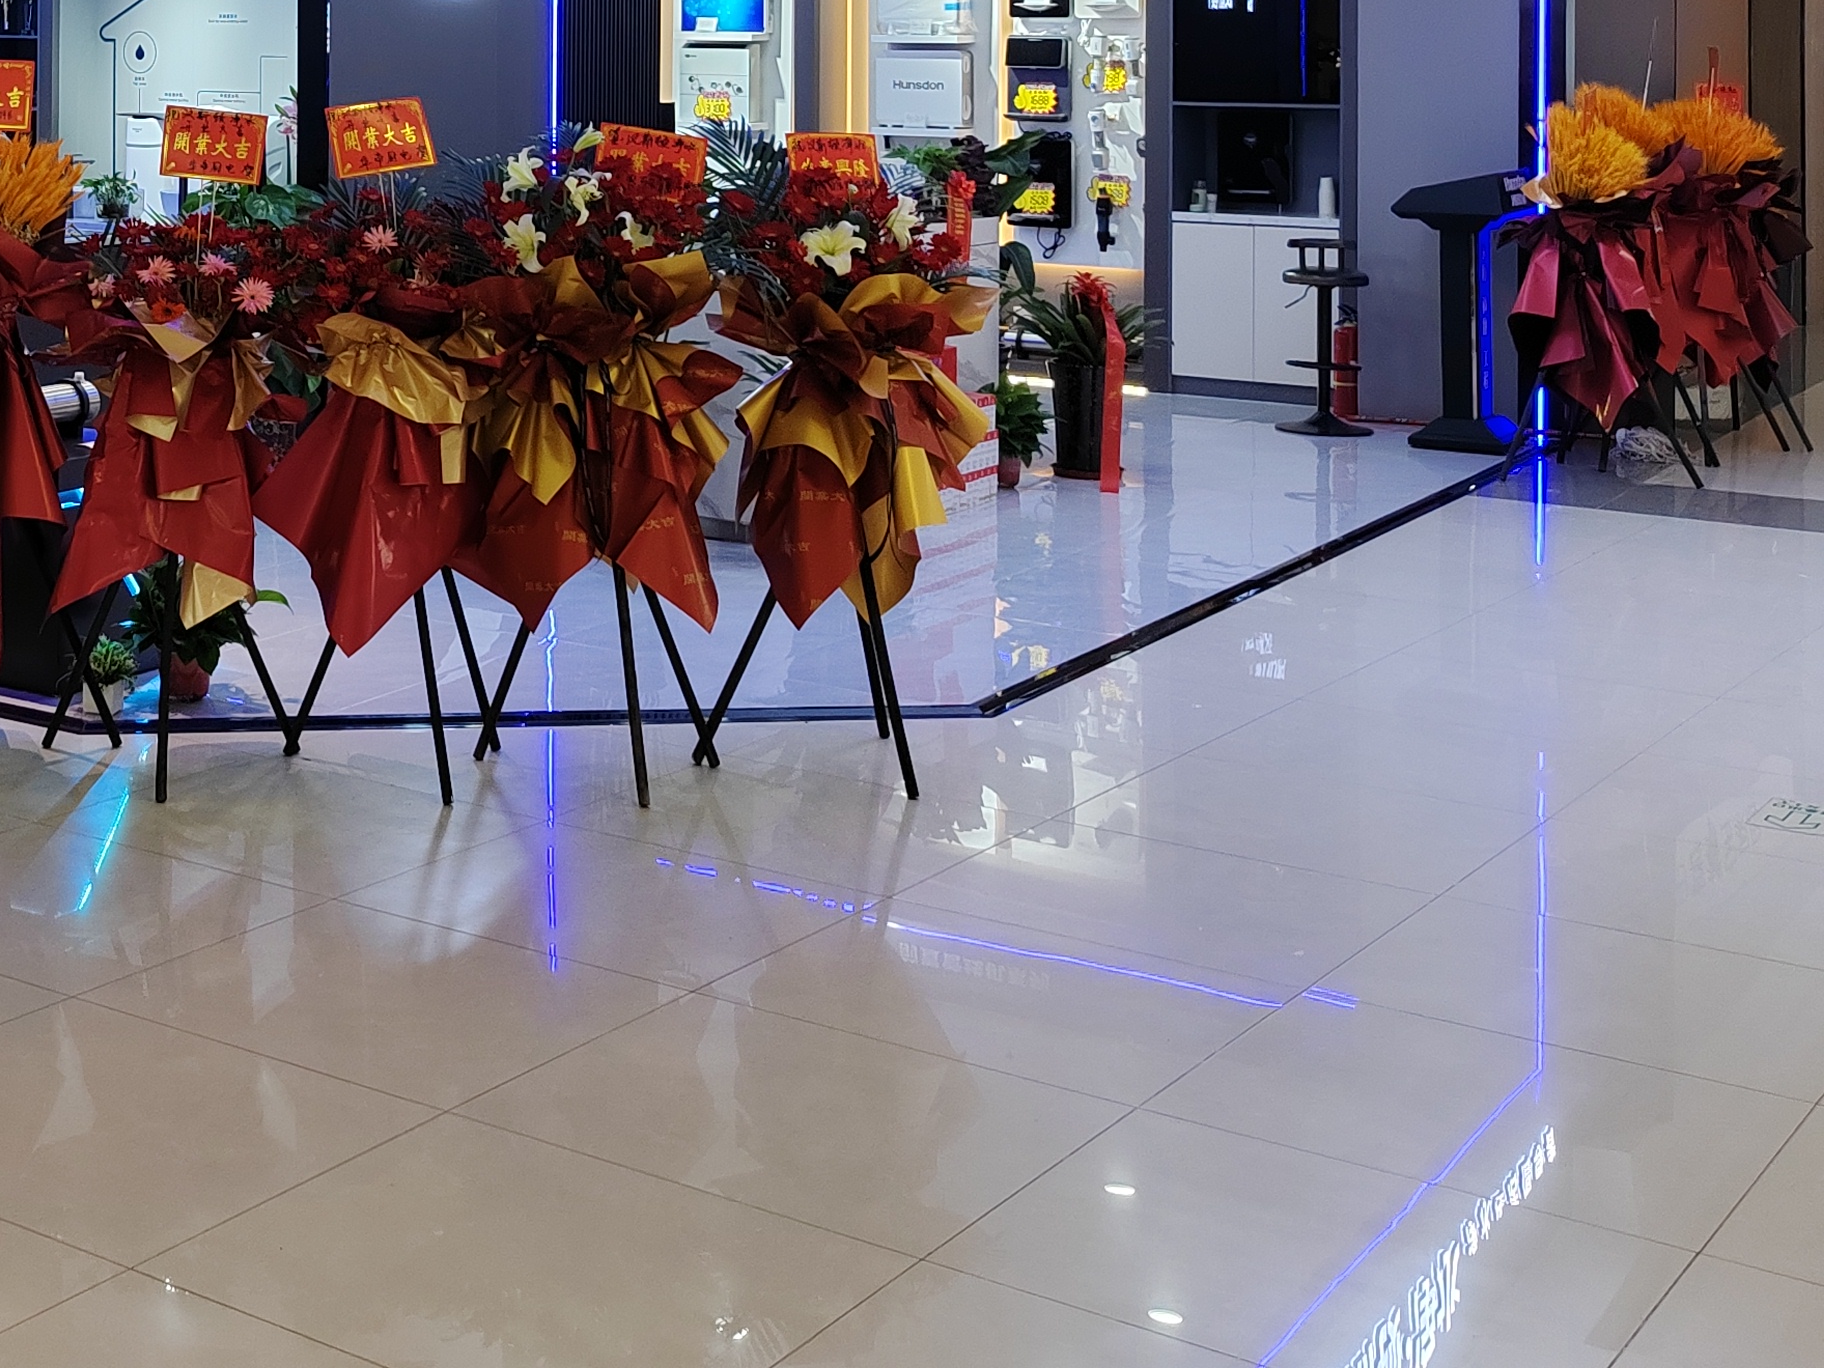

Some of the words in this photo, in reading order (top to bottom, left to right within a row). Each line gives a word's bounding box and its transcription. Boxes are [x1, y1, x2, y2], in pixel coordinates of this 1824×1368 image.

[892, 80, 945, 91] Hunsdon
[173, 132, 252, 160] 開業大吉
[343, 122, 418, 152] 開業大吉
